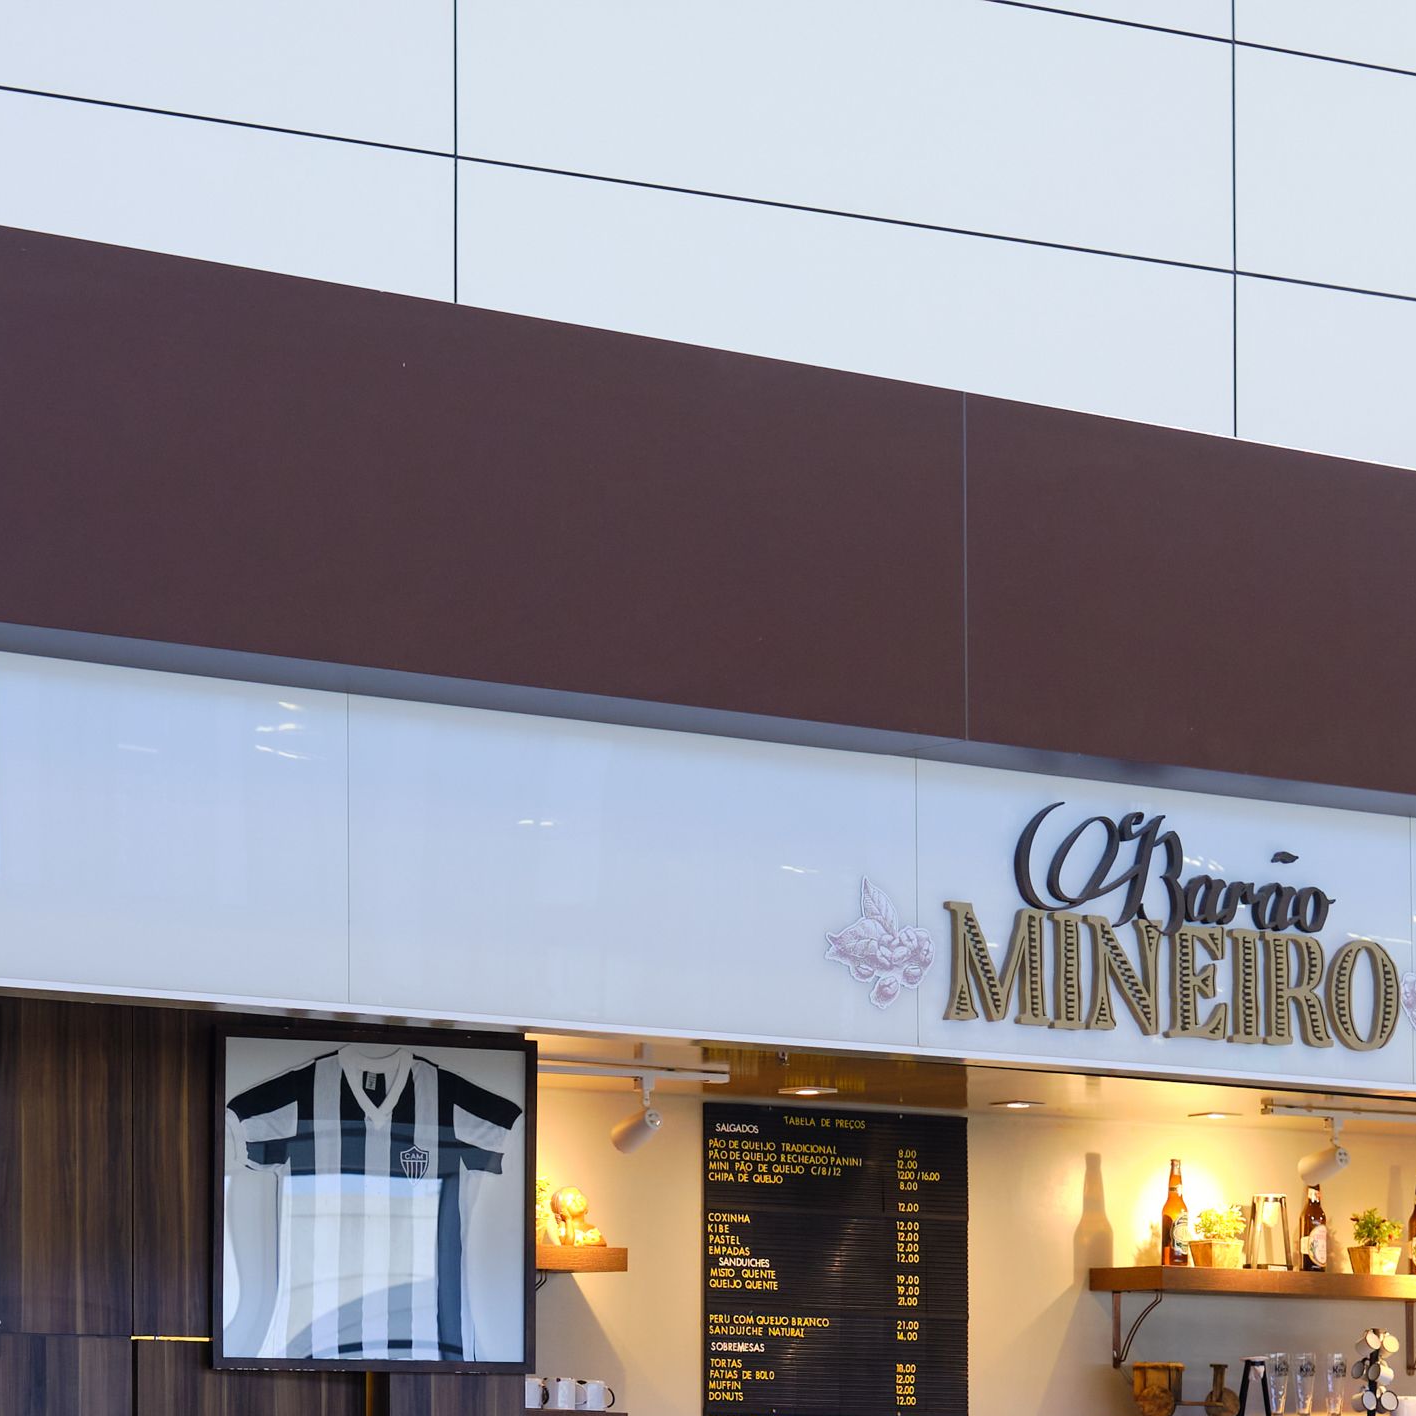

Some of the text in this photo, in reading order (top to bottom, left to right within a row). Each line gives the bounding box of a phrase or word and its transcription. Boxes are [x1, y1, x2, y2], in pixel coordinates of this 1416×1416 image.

[1014, 801, 1336, 936] Barão
[942, 900, 1401, 1052] MINEIRO
[716, 1123, 758, 1133] SALGADOS
[784, 1116, 865, 1129] TABELA DE PREÇOS
[404, 1152, 424, 1160] CAM
[729, 1140, 738, 1148] DE
[742, 1141, 775, 1150] QUEIJO
[781, 1143, 836, 1155] TRADICIONAL
[899, 1150, 916, 1158] 8.00
[730, 1151, 741, 1161] DE
[741, 1152, 776, 1162] QUEIJO
[780, 1154, 828, 1165] RECHEADO
[831, 1157, 862, 1166] PANINI
[897, 1160, 917, 1169] 12.00
[709, 1162, 728, 1170] MINI
[758, 1164, 767, 1172] DE
[772, 1164, 804, 1175] QUEIJO
[709, 1172, 734, 1181] CHIPA
[900, 1182, 917, 1190] 8.00
[899, 1203, 918, 1212] 12.00
[708, 1213, 919, 1232] COXINHA 12.00
[708, 1224, 918, 1241] KIBE 12.00
[709, 1235, 918, 1252] PASTEL 12.00
[709, 1246, 919, 1263] EMPADAS 12.00
[719, 1257, 769, 1268] SANDUICHES
[711, 1268, 919, 1284] MISTO QUENTE 19.00
[710, 1279, 919, 1295] QUEIJO QUENTE 19.00
[710, 1315, 730, 1323] PERU
[733, 1315, 754, 1324] COM
[791, 1317, 829, 1328] BRANCO
[898, 1321, 919, 1330] 21.00
[711, 1342, 764, 1352] SOBREMESAS
[711, 1359, 742, 1368] TORTAS
[710, 1370, 915, 1383] FATIAS DE BOLO 12.00
[709, 1381, 914, 1394] MUFFIN 12.00
[709, 1392, 916, 1405] DONUTS 12.00
